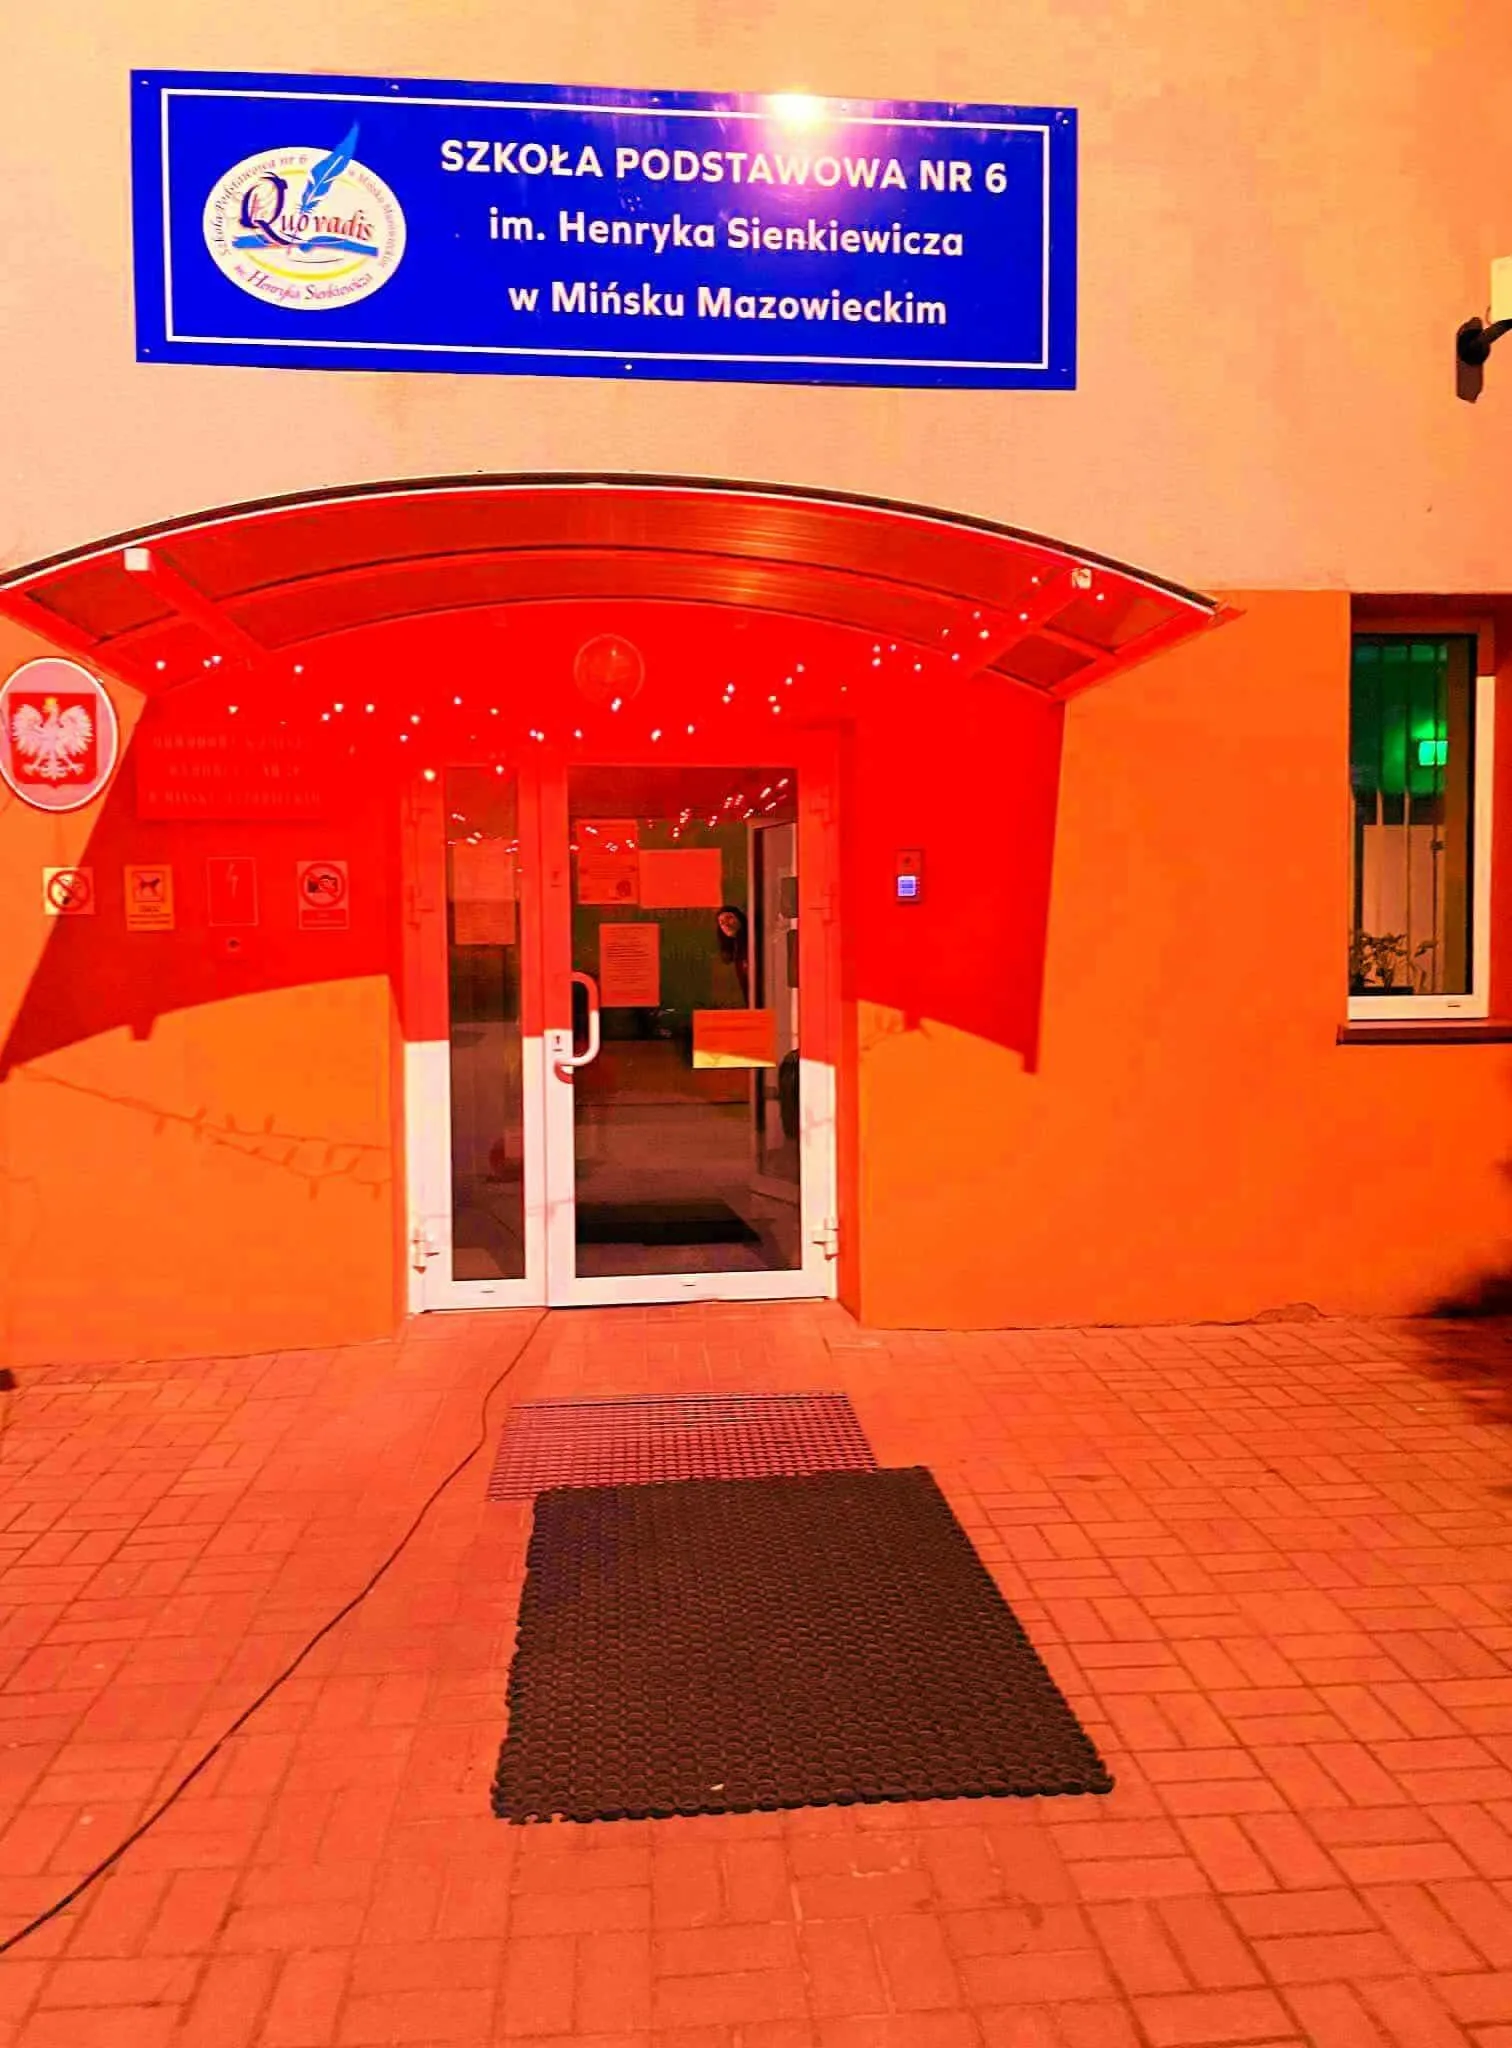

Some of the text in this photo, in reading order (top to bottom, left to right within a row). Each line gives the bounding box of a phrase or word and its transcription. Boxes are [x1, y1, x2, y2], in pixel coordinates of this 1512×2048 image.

[441, 139, 1008, 195] SZKOŁA PODSTAWOWA NR 6
[488, 206, 963, 257] im. Henryka Sienkiewicza
[508, 281, 947, 326] w Mińsku Mazowieckim
